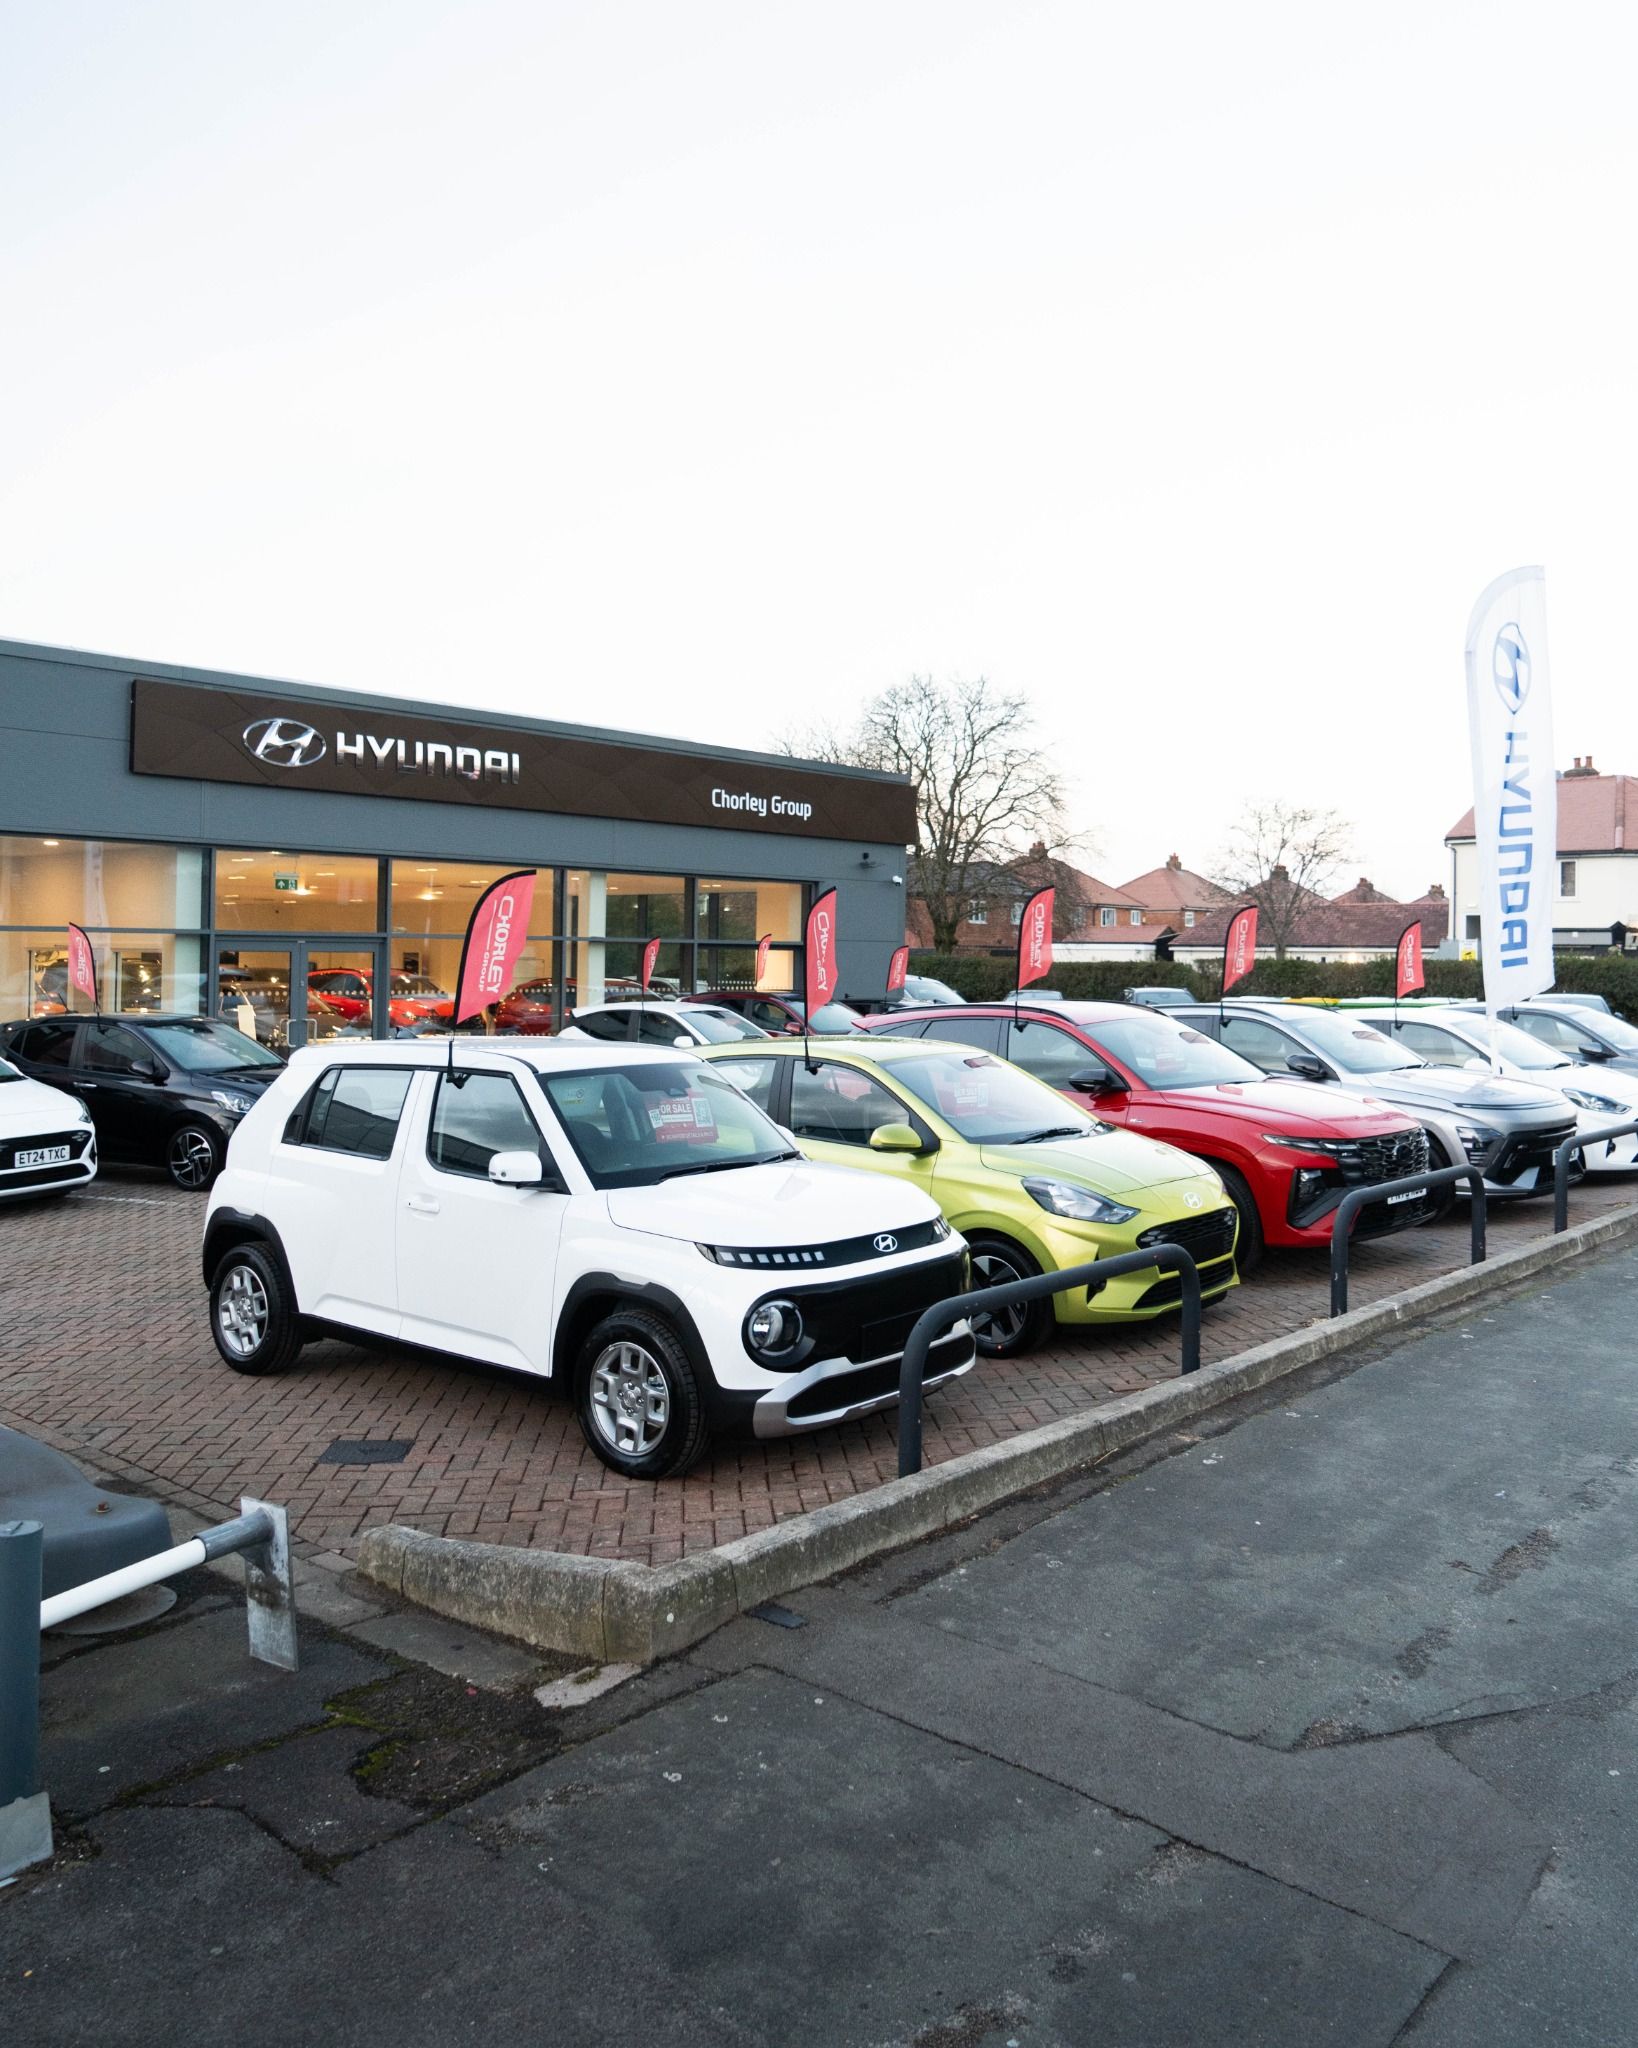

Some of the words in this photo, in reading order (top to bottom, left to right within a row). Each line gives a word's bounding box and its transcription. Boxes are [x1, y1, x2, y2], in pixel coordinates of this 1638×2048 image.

[336, 731, 520, 785] HYUNDAI
[711, 788, 767, 817] Chorley
[771, 795, 812, 821] Group
[1497, 731, 1533, 970] HYUNDAI
[486, 895, 514, 994] CHORLEY
[817, 911, 830, 991] CHOEY
[1034, 903, 1045, 968] CHORLEY
[479, 952, 490, 992] GROUP
[659, 1103, 672, 1114] OR
[672, 1103, 692, 1113] SALE
[19, 1150, 45, 1165] ET24
[48, 1147, 66, 1160] TXC
